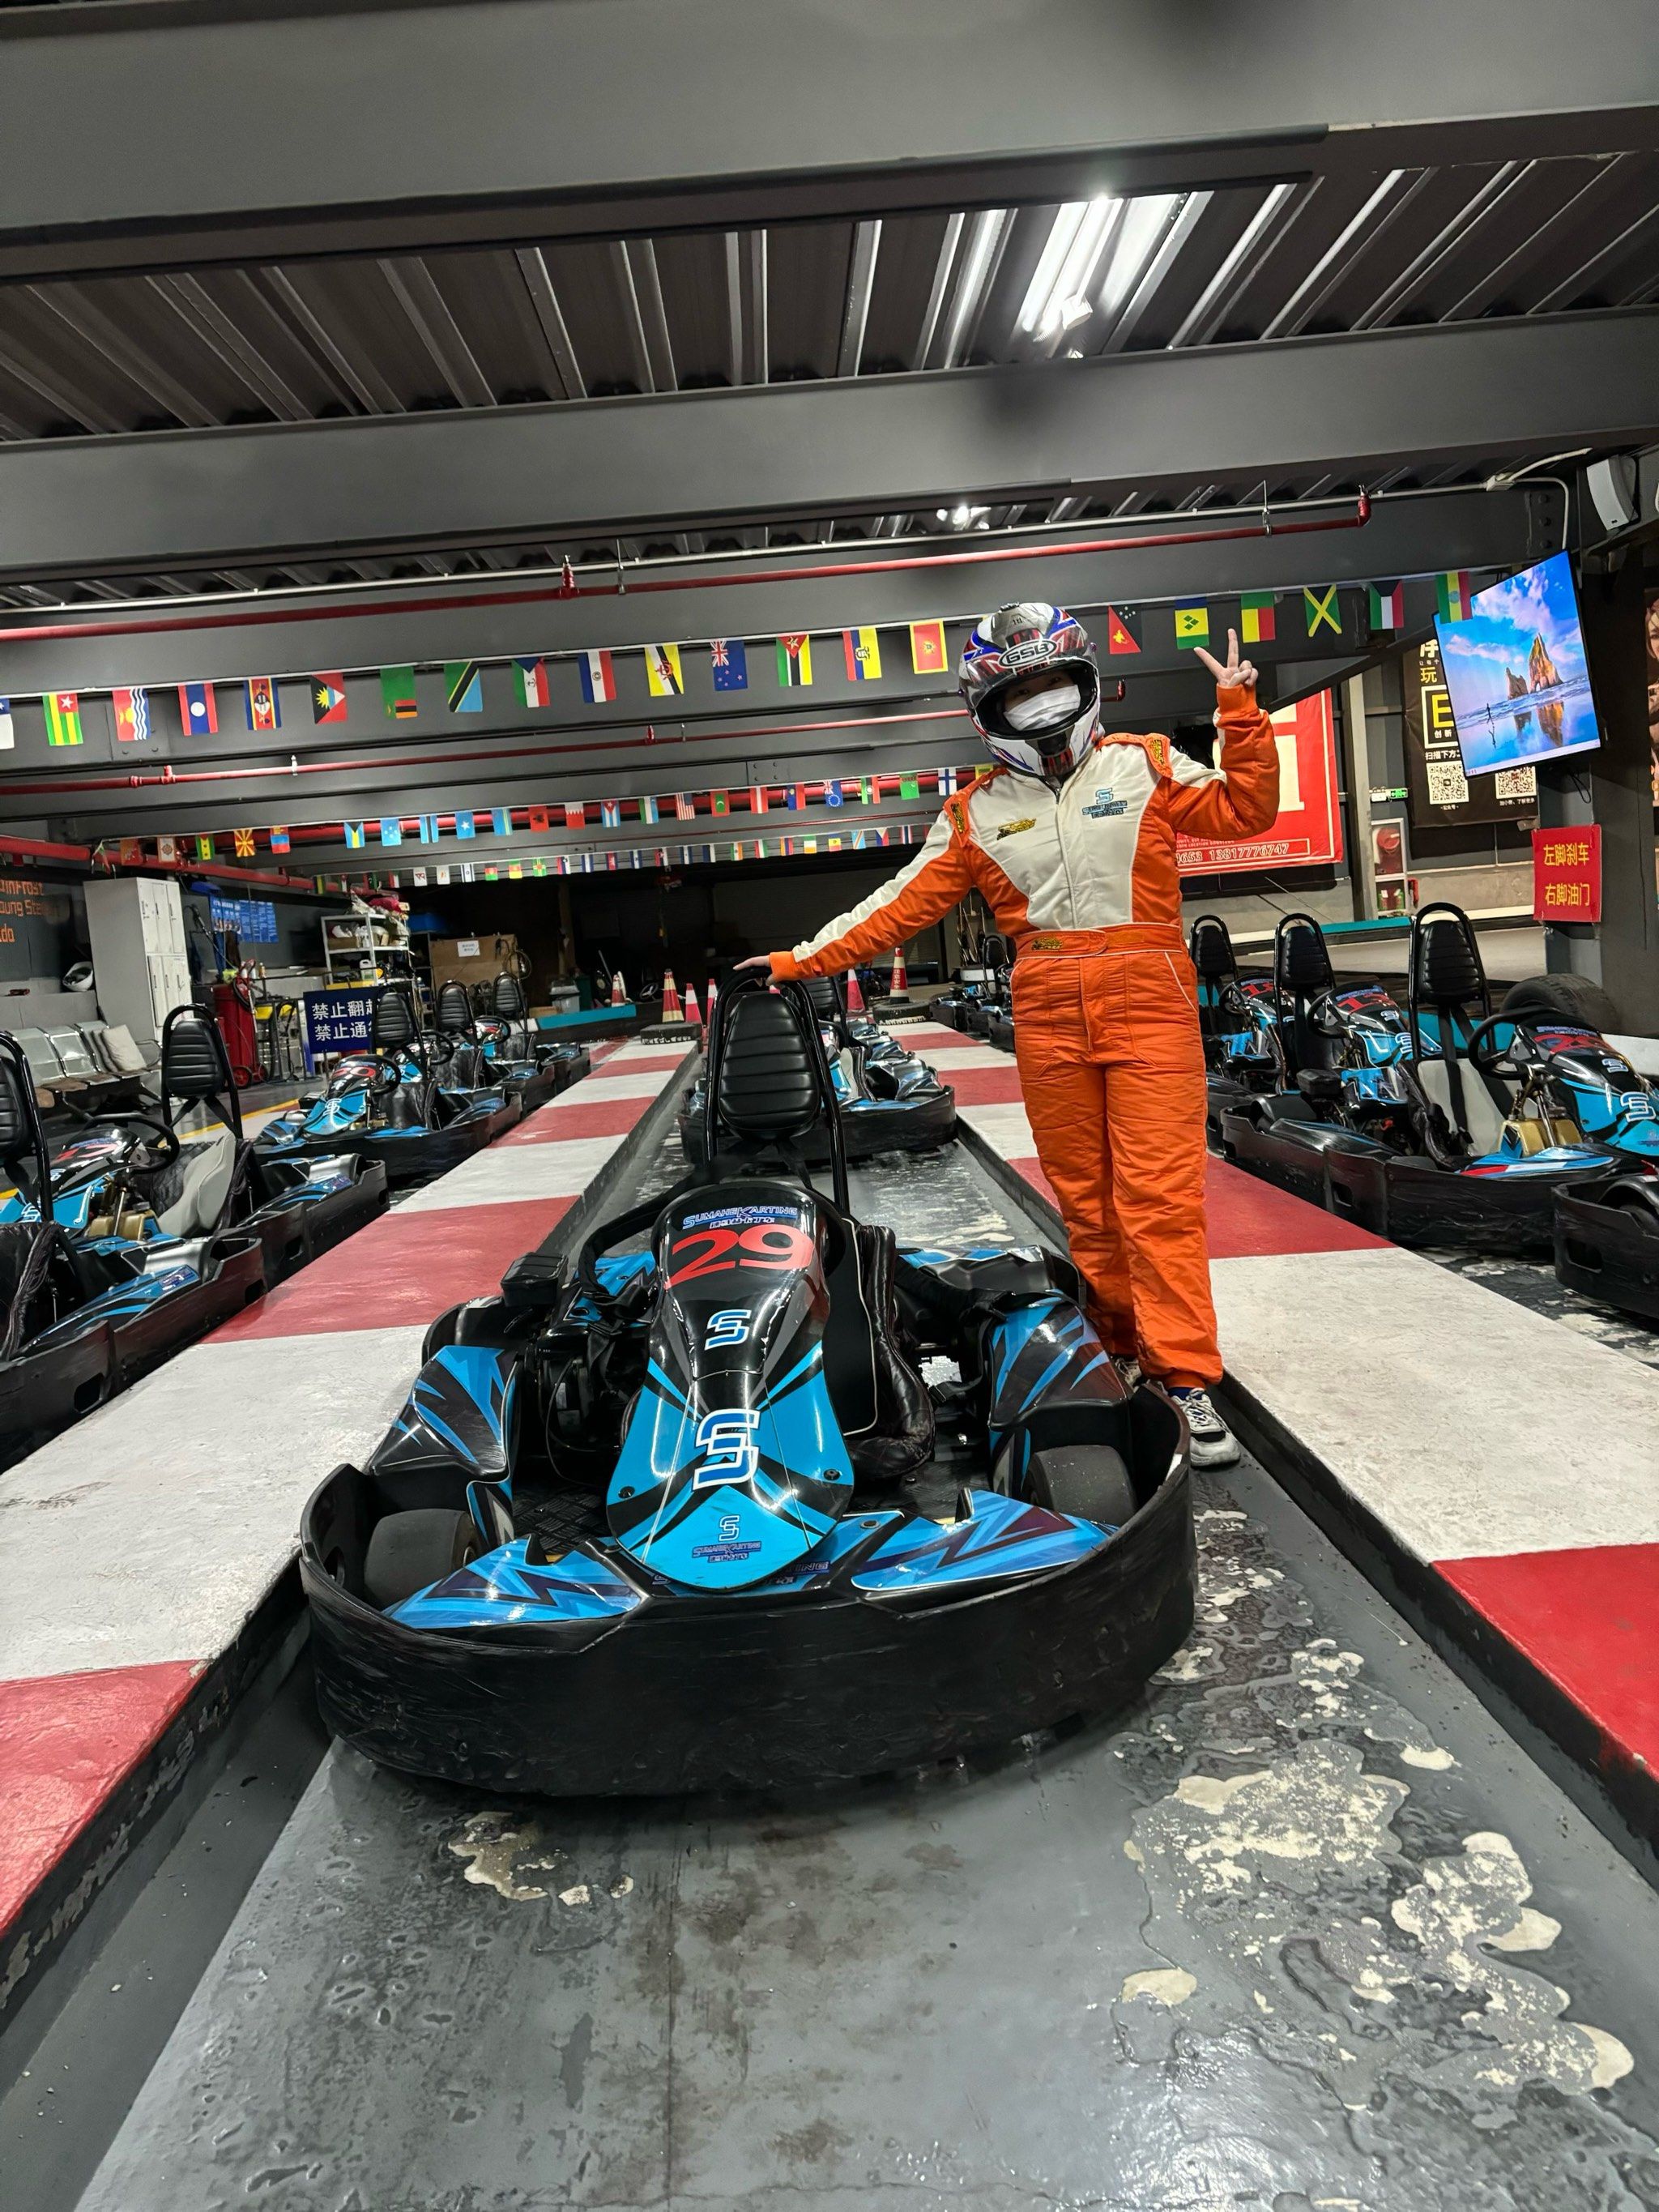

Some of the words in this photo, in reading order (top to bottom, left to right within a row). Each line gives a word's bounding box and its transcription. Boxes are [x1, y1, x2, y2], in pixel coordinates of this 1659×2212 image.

[1543, 843, 1589, 866] 左脚刹车
[1545, 882, 1590, 906] 右脚油门
[314, 1021, 372, 1042] 禁止通
[663, 1223, 815, 1290] 29
